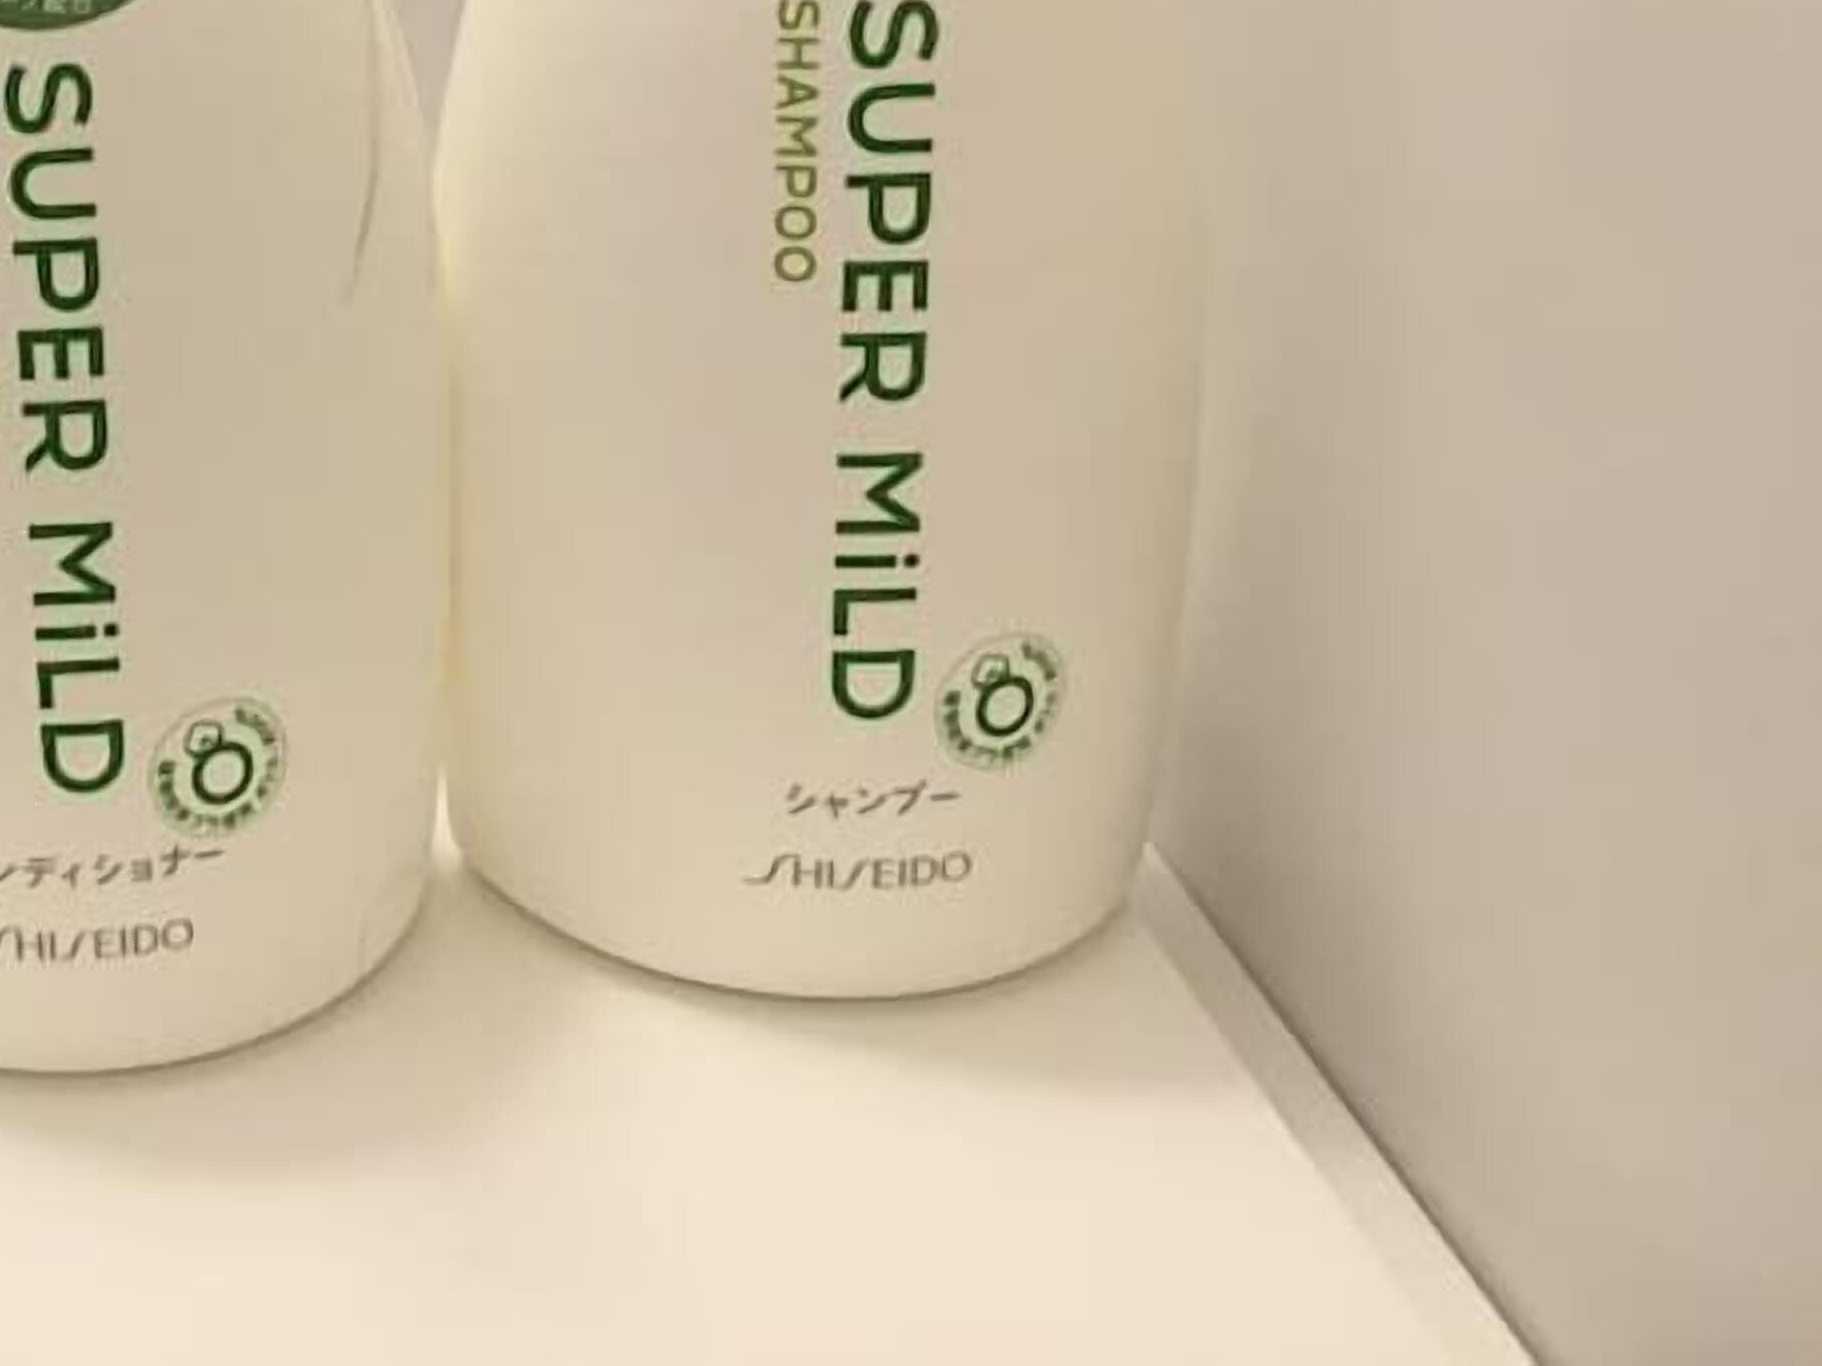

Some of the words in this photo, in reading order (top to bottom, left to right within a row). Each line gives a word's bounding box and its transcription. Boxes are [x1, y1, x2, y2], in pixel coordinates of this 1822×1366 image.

[3, 62, 111, 473] SUPER
[785, 778, 960, 818] シャンプー
[740, 849, 974, 891] SHISEIDO
